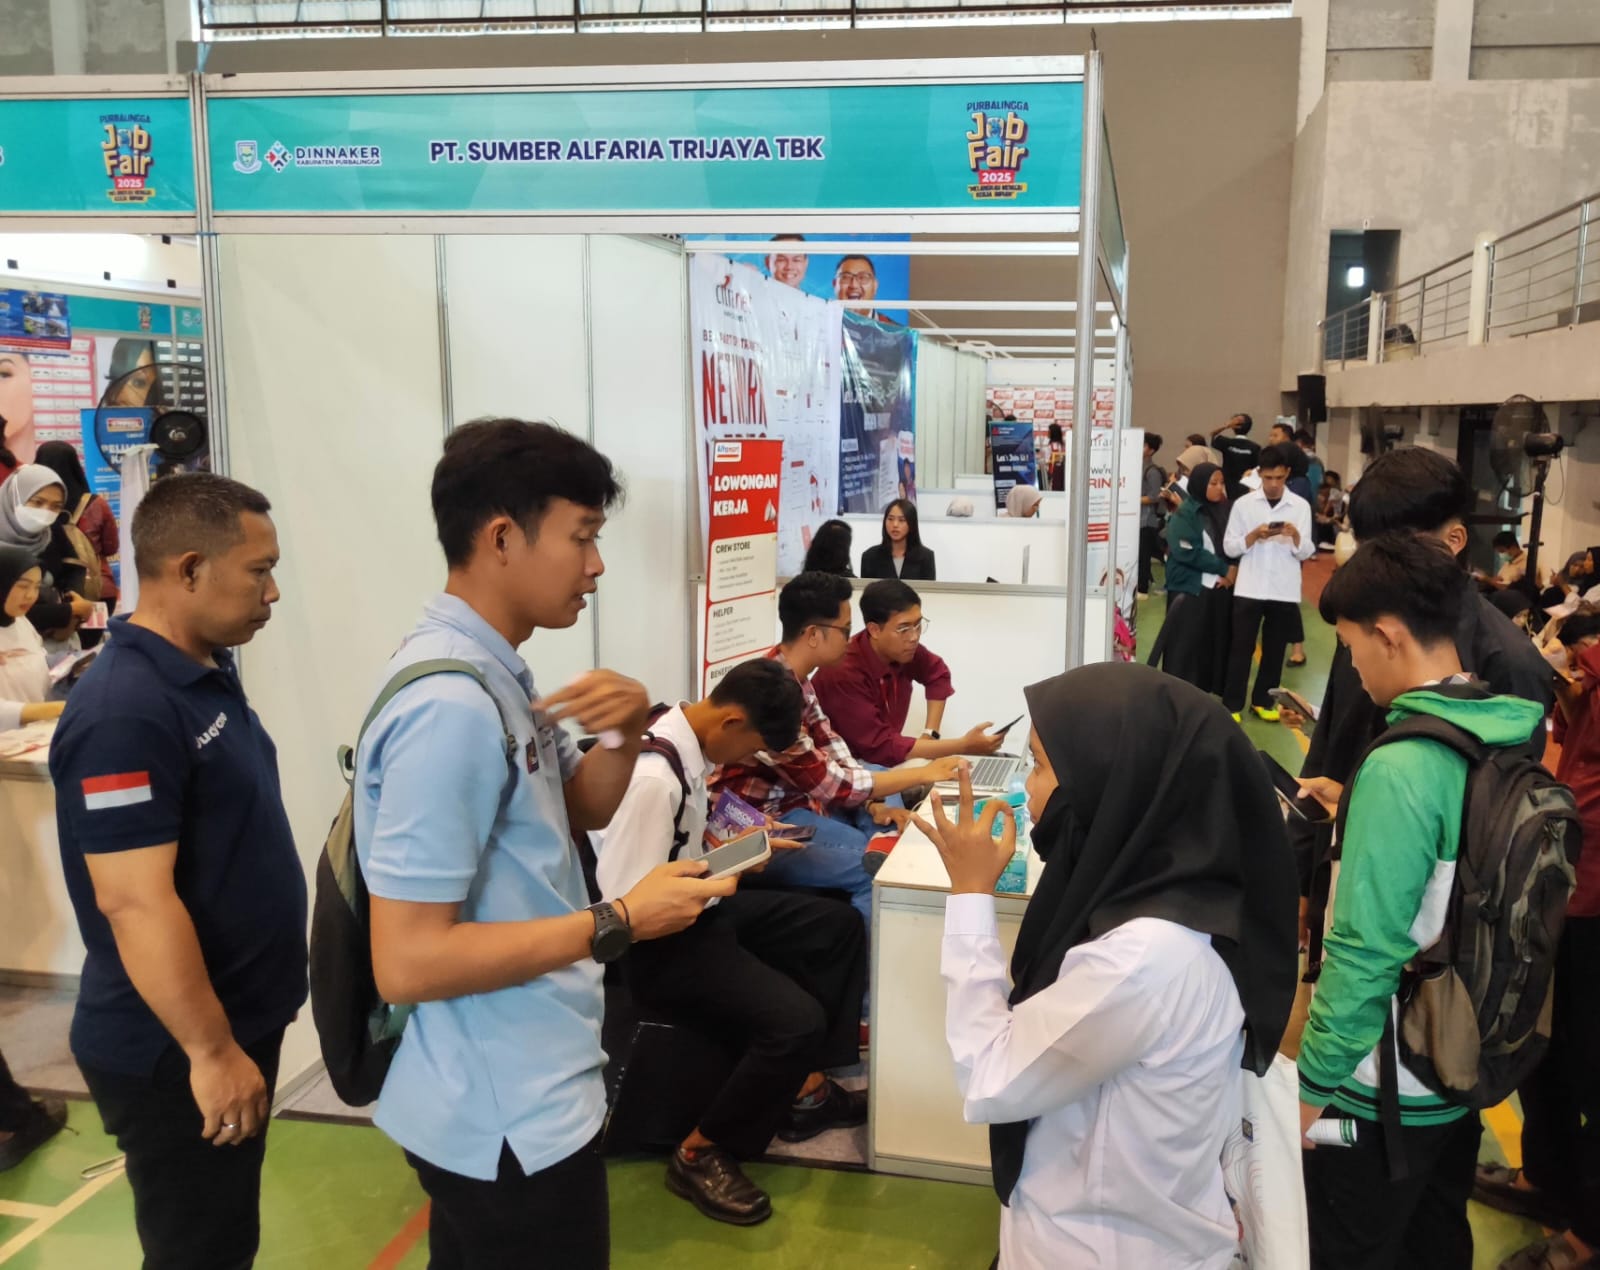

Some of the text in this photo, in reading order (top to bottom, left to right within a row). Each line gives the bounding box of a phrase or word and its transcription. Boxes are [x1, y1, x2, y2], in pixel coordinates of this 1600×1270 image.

[967, 101, 1029, 111] PURBALINGGA
[966, 112, 1026, 141] Job
[296, 147, 380, 159] DINNAKER
[431, 138, 822, 161] PT. SUMBER ALFARIA TRIJAYA TBK
[968, 140, 1026, 169] Fair
[104, 150, 152, 177] Fair
[117, 179, 142, 188] 2025
[982, 172, 1012, 182] 2025
[714, 473, 778, 492] LOWONGAN
[713, 499, 749, 517] KERJA
[715, 541, 751, 554] CREW STORE
[713, 606, 734, 618] HELPER
